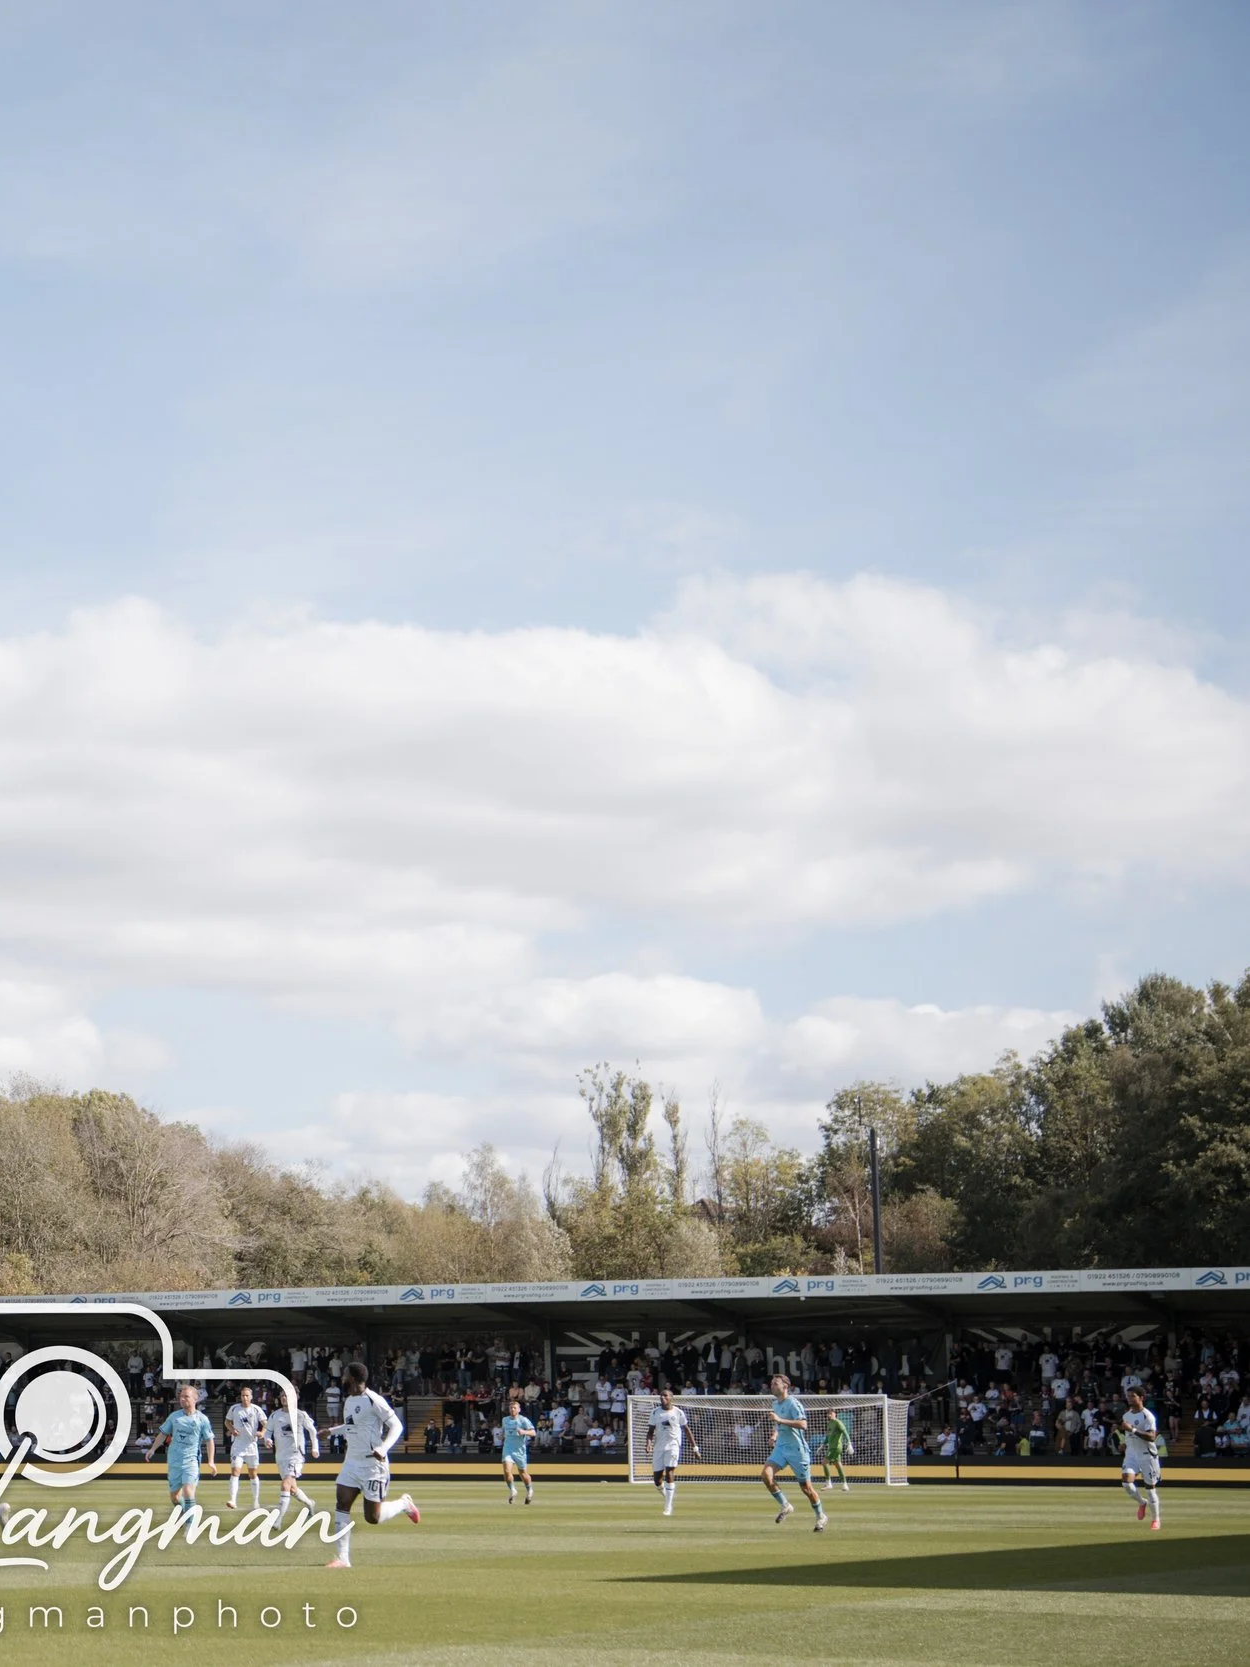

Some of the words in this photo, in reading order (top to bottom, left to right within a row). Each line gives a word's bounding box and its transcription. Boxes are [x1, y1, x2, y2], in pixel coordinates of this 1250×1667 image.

[807, 1279, 834, 1291] prg
[1014, 1276, 1043, 1287] prg
[430, 1288, 455, 1299] prg
[613, 1284, 639, 1295] prg
[257, 1291, 281, 1303] prg
[368, 1480, 379, 1492] 10
